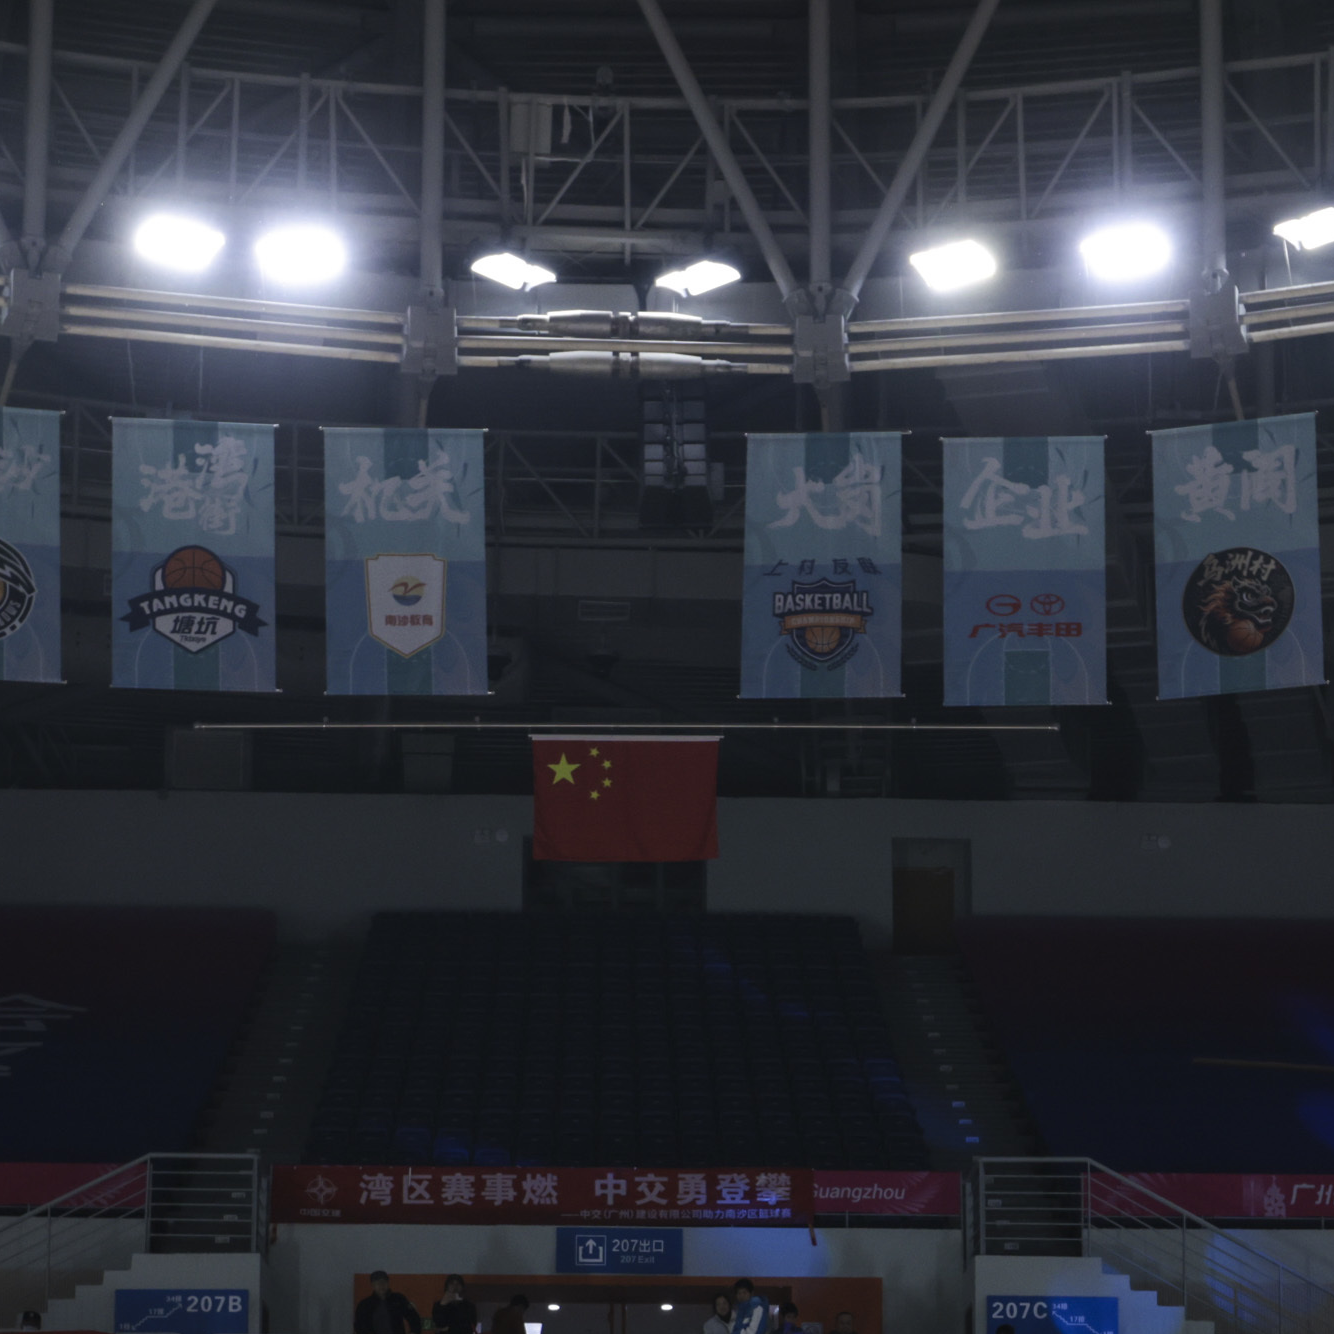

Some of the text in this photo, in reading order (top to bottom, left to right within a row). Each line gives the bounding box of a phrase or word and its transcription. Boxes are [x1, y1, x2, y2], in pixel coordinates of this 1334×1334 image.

[960, 457, 1090, 540] 企业
[139, 593, 248, 619] TANGKENG
[773, 591, 874, 615] BASKETBALL
[170, 614, 221, 636] 塘坑
[969, 621, 1084, 638] 广汽丰田
[358, 1172, 793, 1207] 湾区赛事燃 中交勇登攀
[611, 1238, 665, 1253] 207出口
[620, 1255, 656, 1264] 207 Exit
[186, 1295, 243, 1312] 207B
[991, 1302, 1048, 1319] 207C
